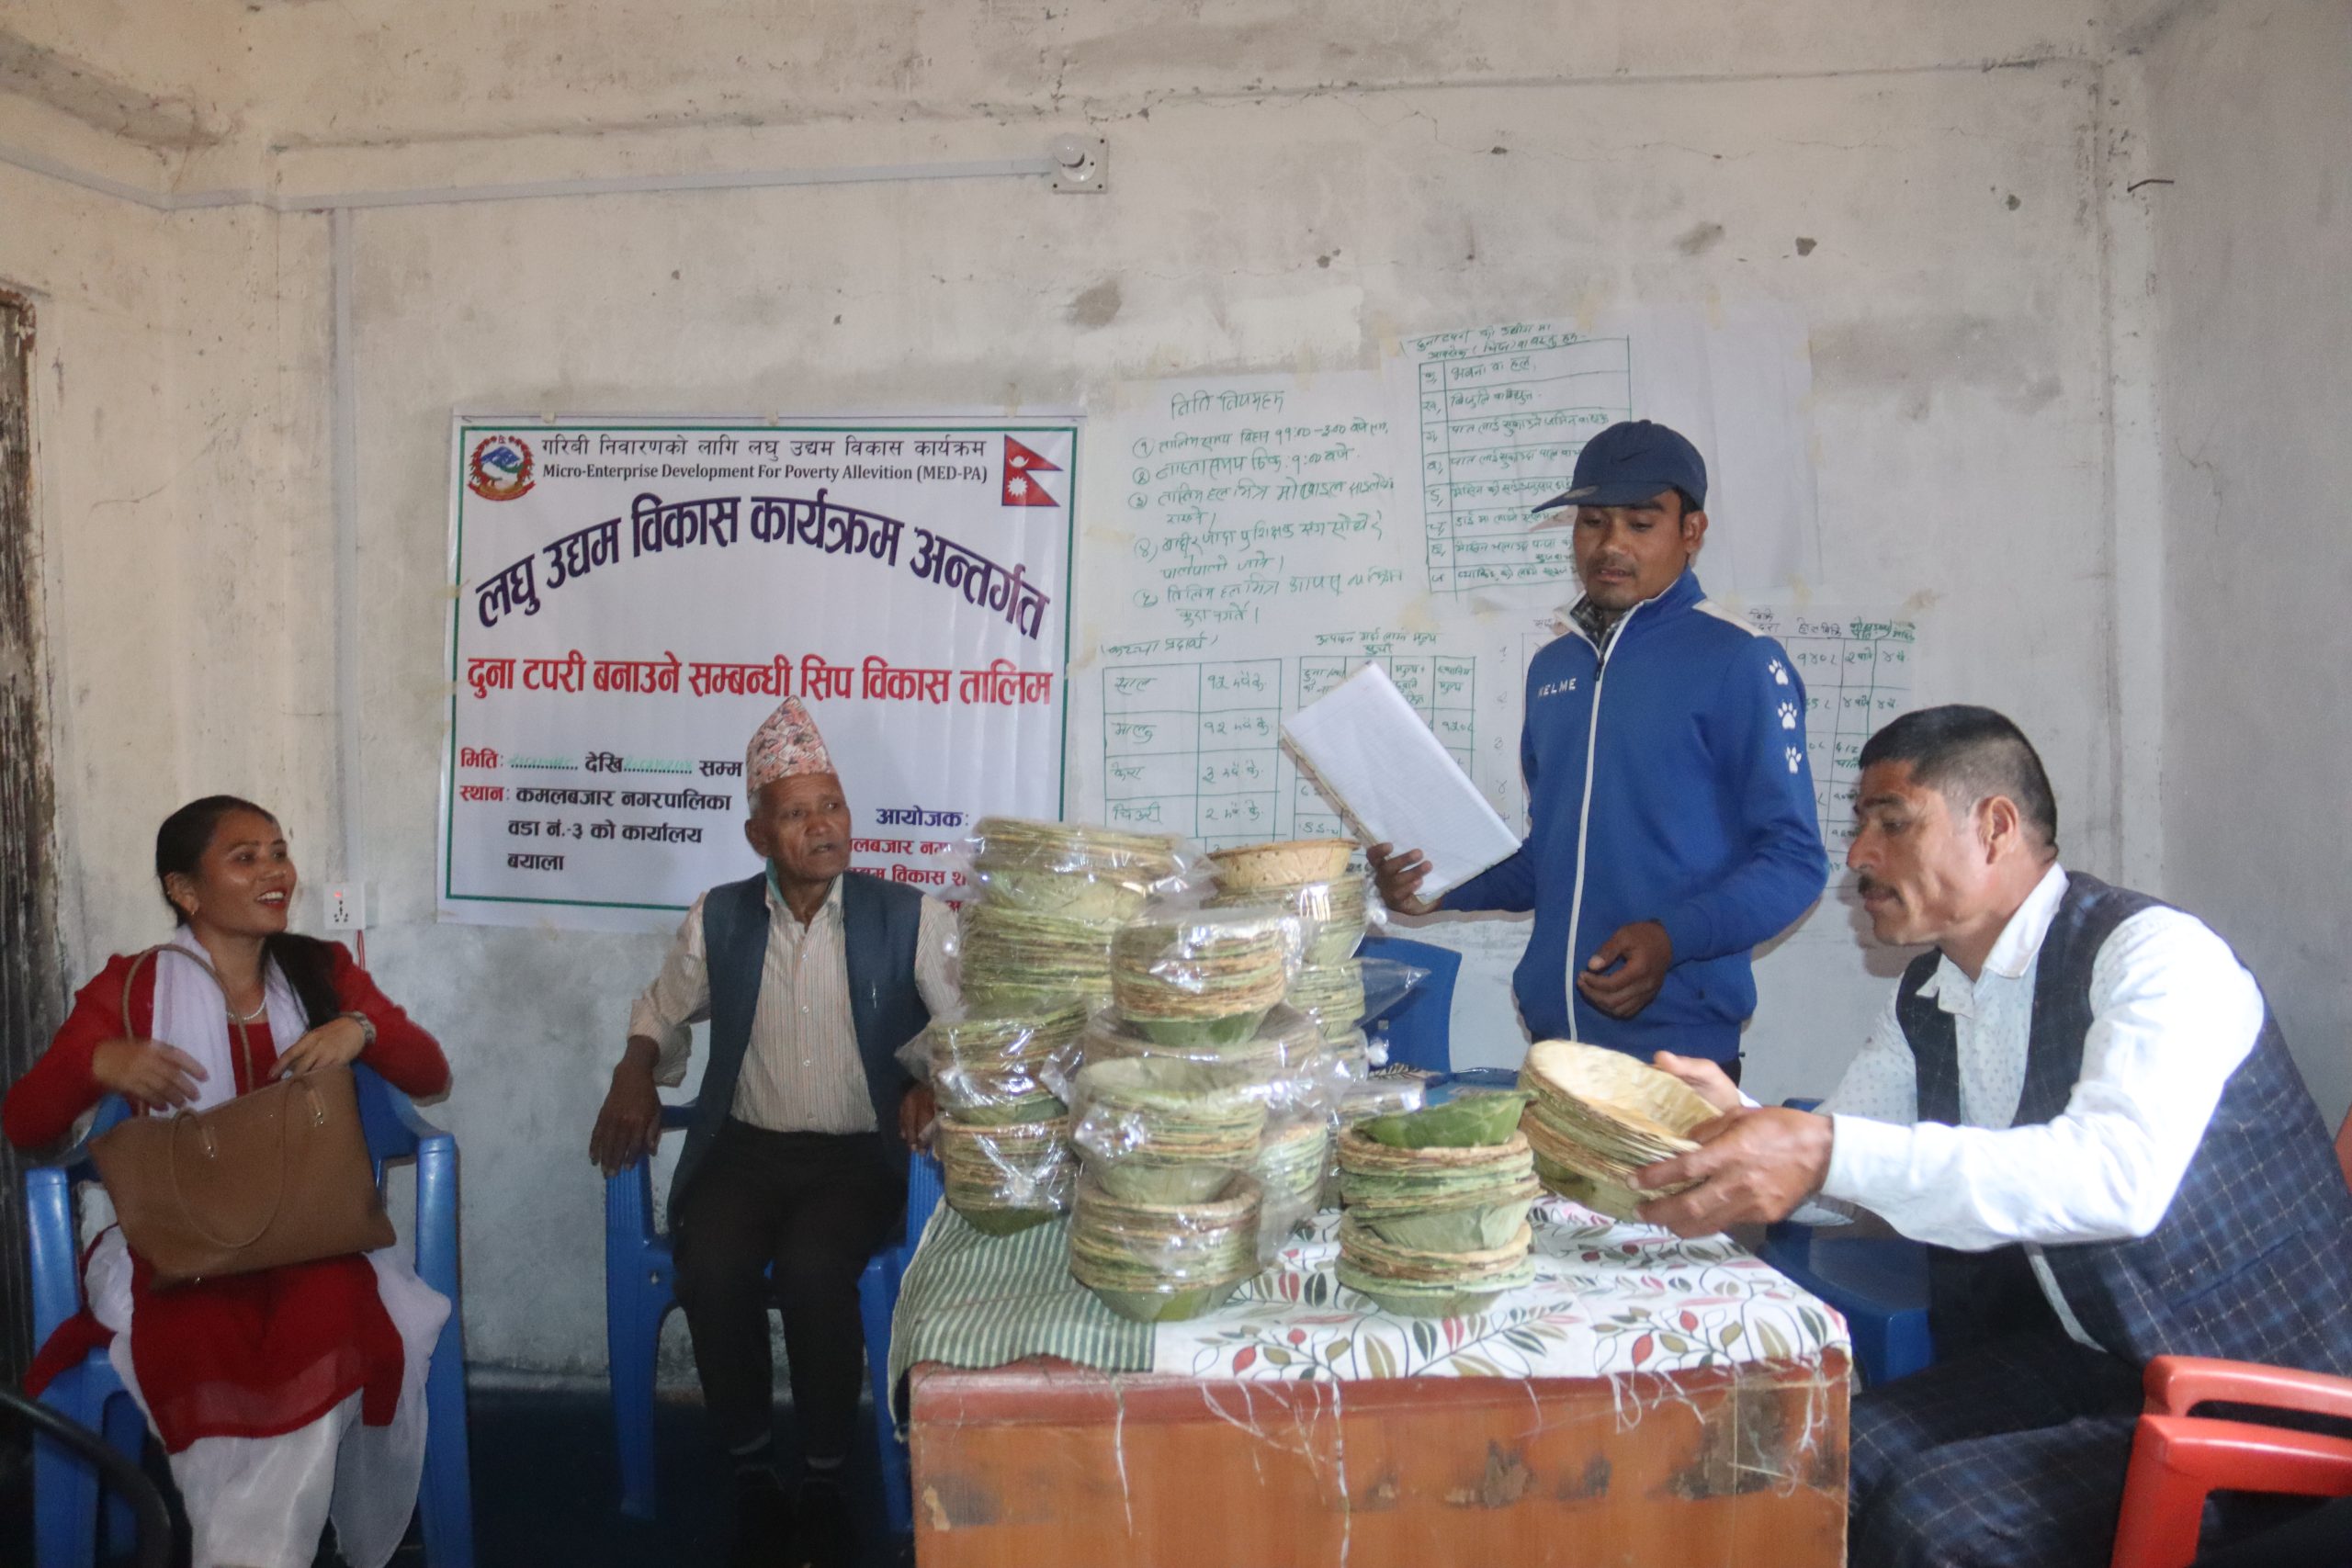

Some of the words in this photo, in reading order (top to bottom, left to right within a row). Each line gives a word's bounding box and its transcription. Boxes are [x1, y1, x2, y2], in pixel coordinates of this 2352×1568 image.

[542, 434, 590, 455] गरिबी
[599, 434, 688, 456] निवारणको
[698, 434, 739, 455] लागि
[748, 440, 779, 461] लघु
[790, 440, 835, 456] उद्यम
[845, 434, 904, 456] विकास
[914, 434, 988, 457] कार्यक्रम
[543, 464, 658, 482] Micro-Enterprise
[662, 464, 753, 482] Development
[758, 465, 781, 478] For
[785, 466, 839, 482] Poverty
[842, 466, 912, 479] Allevition
[916, 466, 988, 483] (MED-PA)
[475, 554, 540, 627] लघु
[543, 517, 621, 589] उद्यम
[631, 492, 741, 558] विकास
[751, 488, 905, 567] कार्यक्रम
[910, 526, 1050, 640] अन्तर्गत
[468, 659, 516, 698] दुना
[523, 649, 586, 693] टपरी
[593, 651, 682, 694] बनाउने
[689, 654, 793, 696] सम्बन्धी
[800, 653, 854, 701] सिप
[862, 655, 952, 705] विकास
[960, 659, 1053, 705] तालिम
[585, 751, 624, 773] देखि
[699, 761, 743, 777] सम्म
[515, 787, 616, 807] कमलबजार
[621, 788, 733, 810] नगरपालिका
[508, 820, 540, 837] वडा
[591, 819, 616, 840] को
[622, 823, 703, 843] कार्यालय
[507, 853, 564, 871] बयाला
